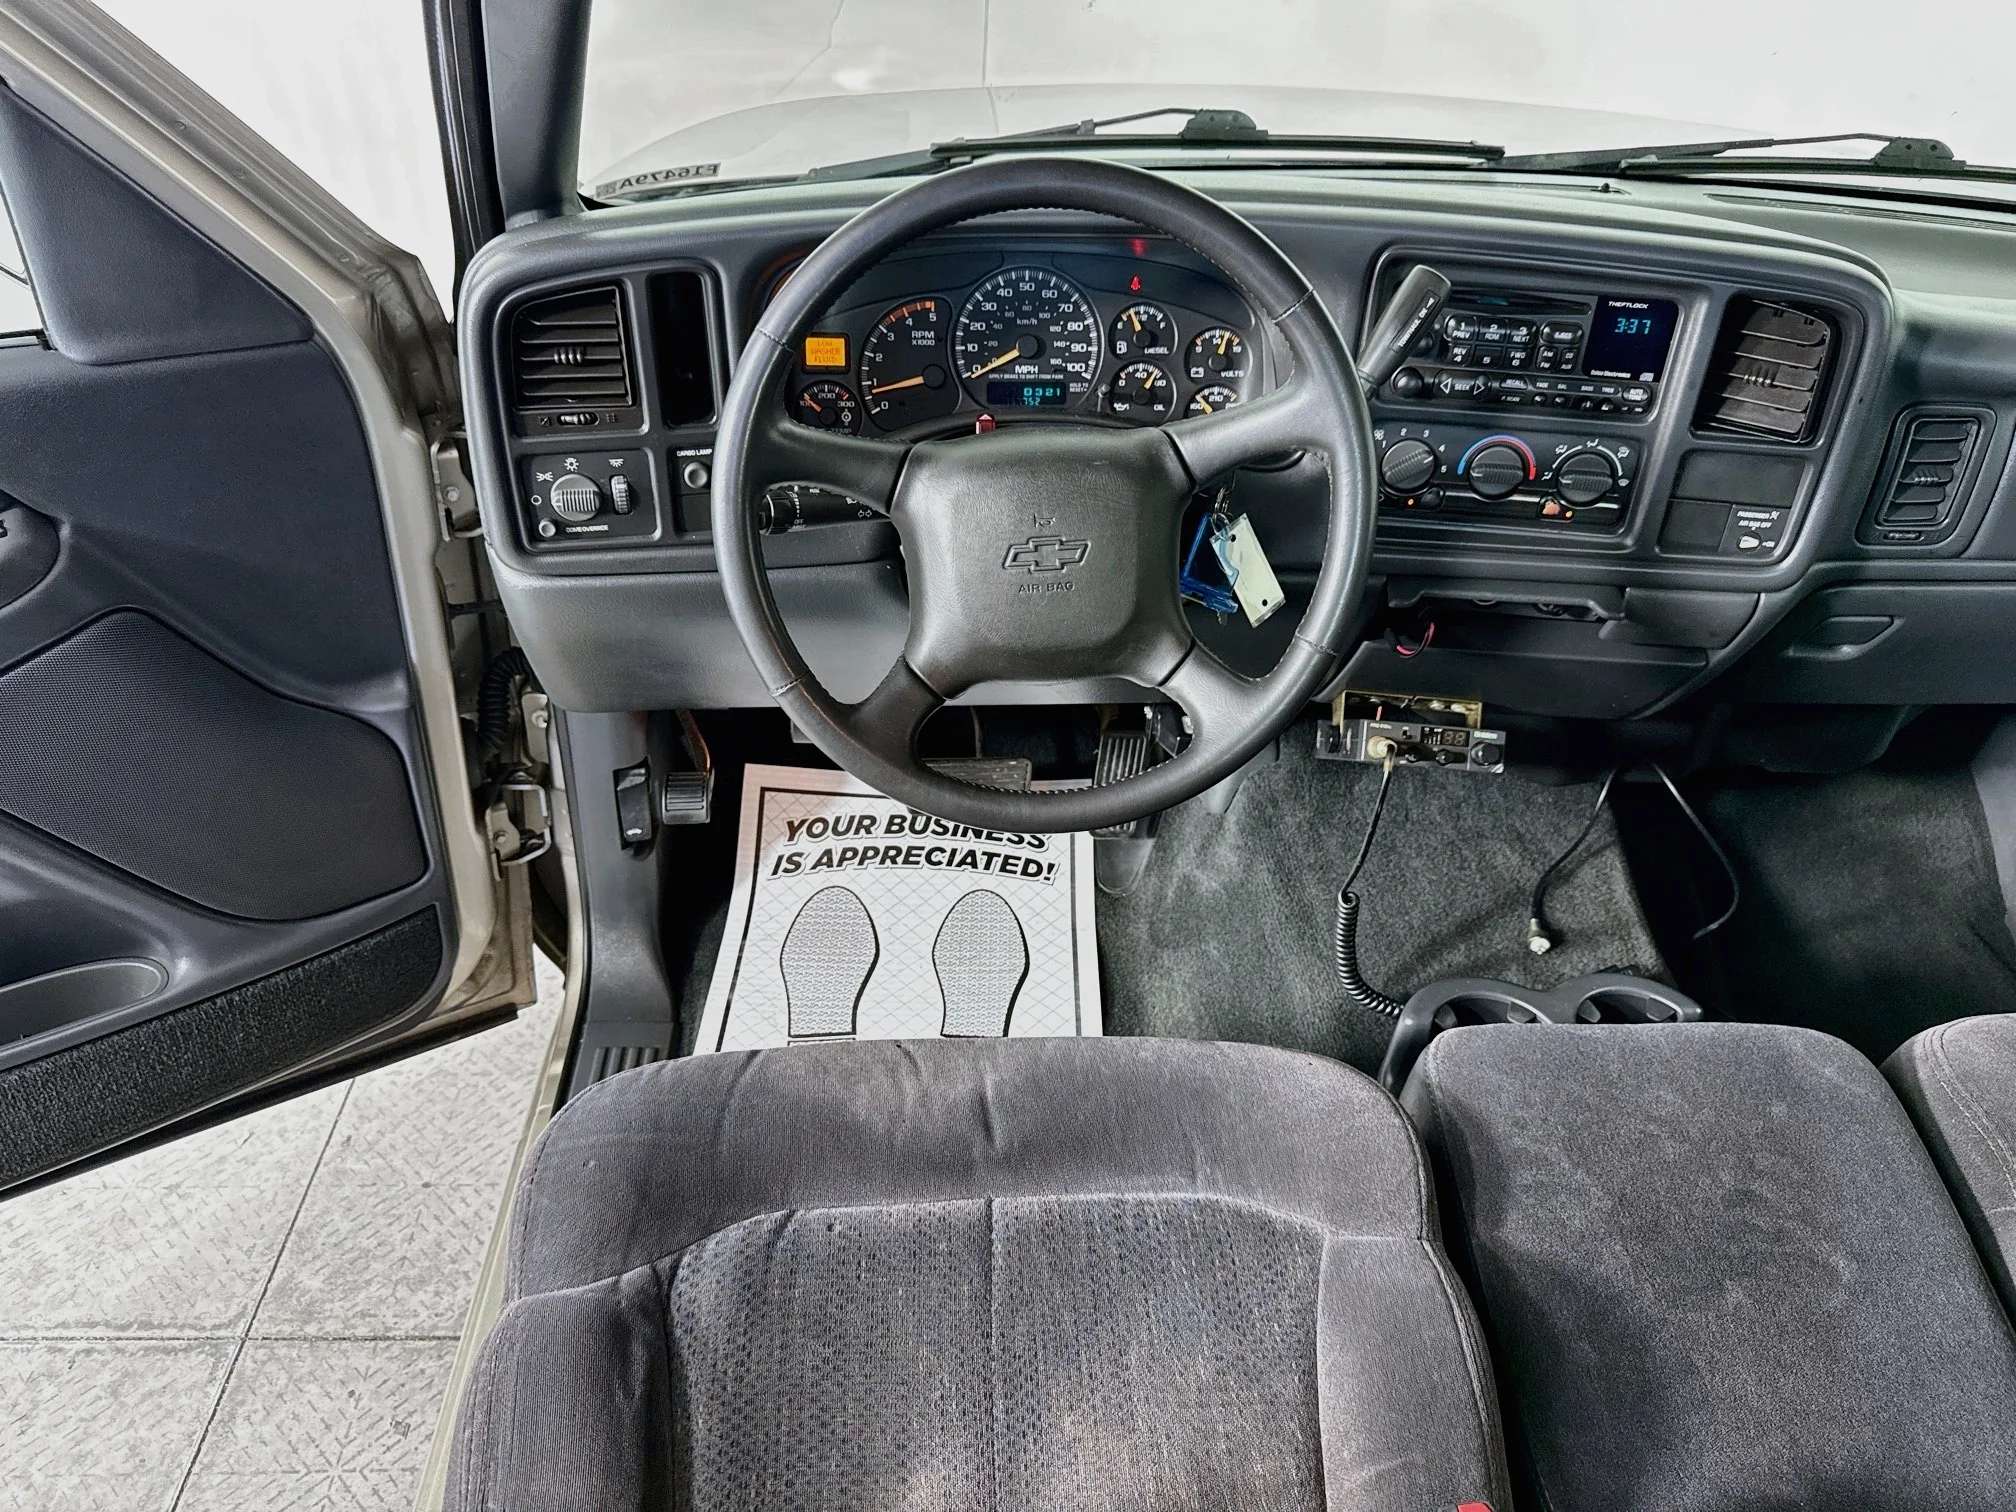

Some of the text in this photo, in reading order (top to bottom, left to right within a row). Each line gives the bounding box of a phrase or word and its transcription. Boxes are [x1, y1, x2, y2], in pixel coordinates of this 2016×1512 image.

[1019, 282, 1035, 291] 50
[996, 288, 1013, 297] 40
[1041, 289, 1058, 298] 60
[981, 302, 997, 311] 30
[1058, 303, 1073, 312] 70
[1608, 300, 1649, 309] THEFTLOCK
[929, 313, 937, 321] 5
[905, 318, 913, 326] 4
[969, 322, 986, 331] 20
[1067, 322, 1084, 331] 80
[1615, 317, 1651, 334] 3:37
[1489, 324, 1498, 332] 2
[1519, 327, 1528, 335] 3
[887, 332, 895, 341] 3
[911, 331, 935, 339] RPM
[1452, 331, 1470, 339] PREV
[967, 343, 978, 352] 10
[1071, 343, 1087, 352] 90
[1453, 347, 1467, 355] REV
[875, 353, 883, 361] 2
[1510, 351, 1526, 359] FWD
[972, 364, 981, 373] 0
[1015, 365, 1039, 373] MPH
[1066, 362, 1086, 372] 100
[881, 401, 889, 409] 0
[1400, 428, 1407, 436] 2
[1423, 429, 1430, 437] 3
[1438, 444, 1445, 452] 4
[1441, 465, 1447, 473] 5
[1019, 581, 1075, 594] AIR BAG
[784, 813, 878, 843] YOUR
[771, 845, 1060, 882] IS APPRECIATED!
